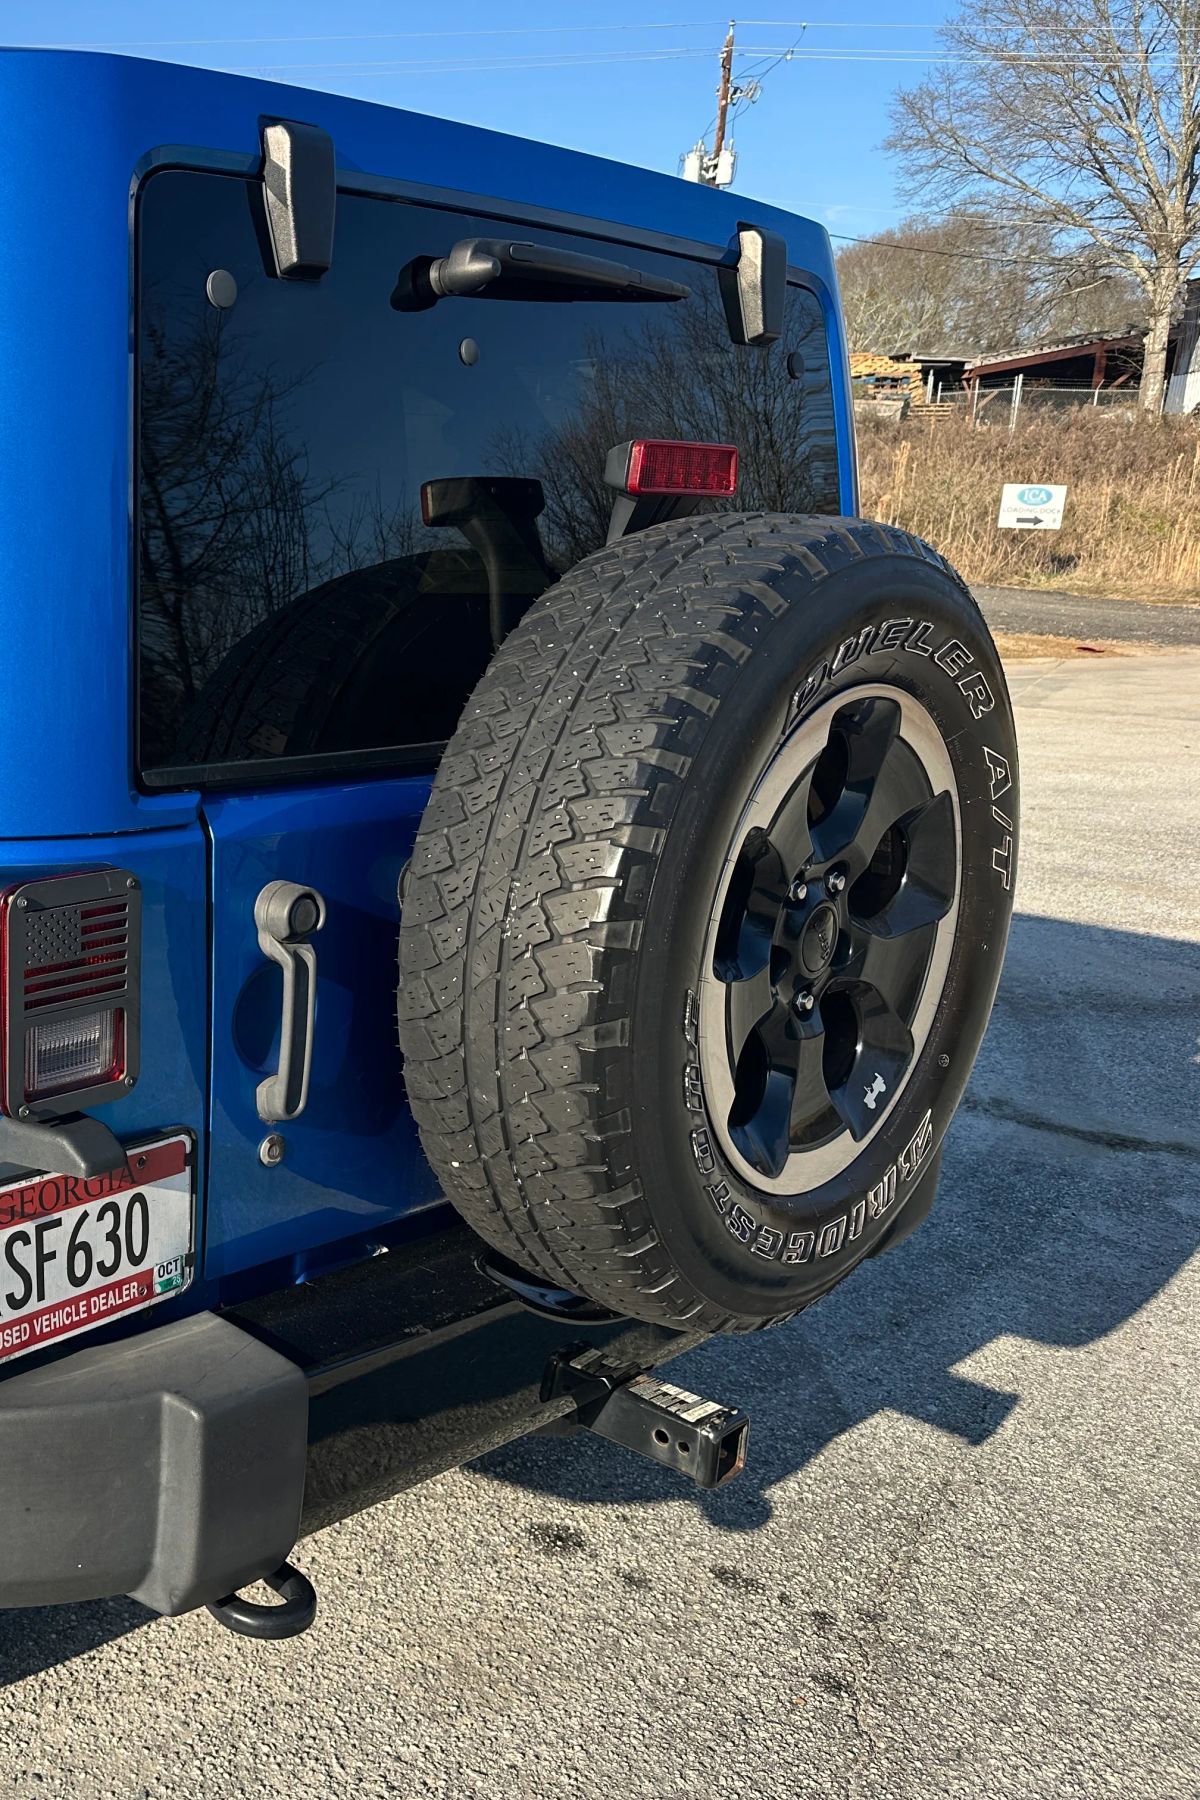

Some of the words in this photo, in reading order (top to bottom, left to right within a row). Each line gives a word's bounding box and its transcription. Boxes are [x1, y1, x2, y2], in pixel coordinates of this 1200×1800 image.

[1023, 489, 1048, 501] ICA
[781, 616, 996, 737] DUELER
[982, 745, 1013, 892] A/T
[684, 987, 934, 1264] BRIDGESTONE
[157, 1257, 180, 1279] OCT
[33, 1301, 88, 1336] VEHICLE
[90, 1281, 139, 1312] DEALER
